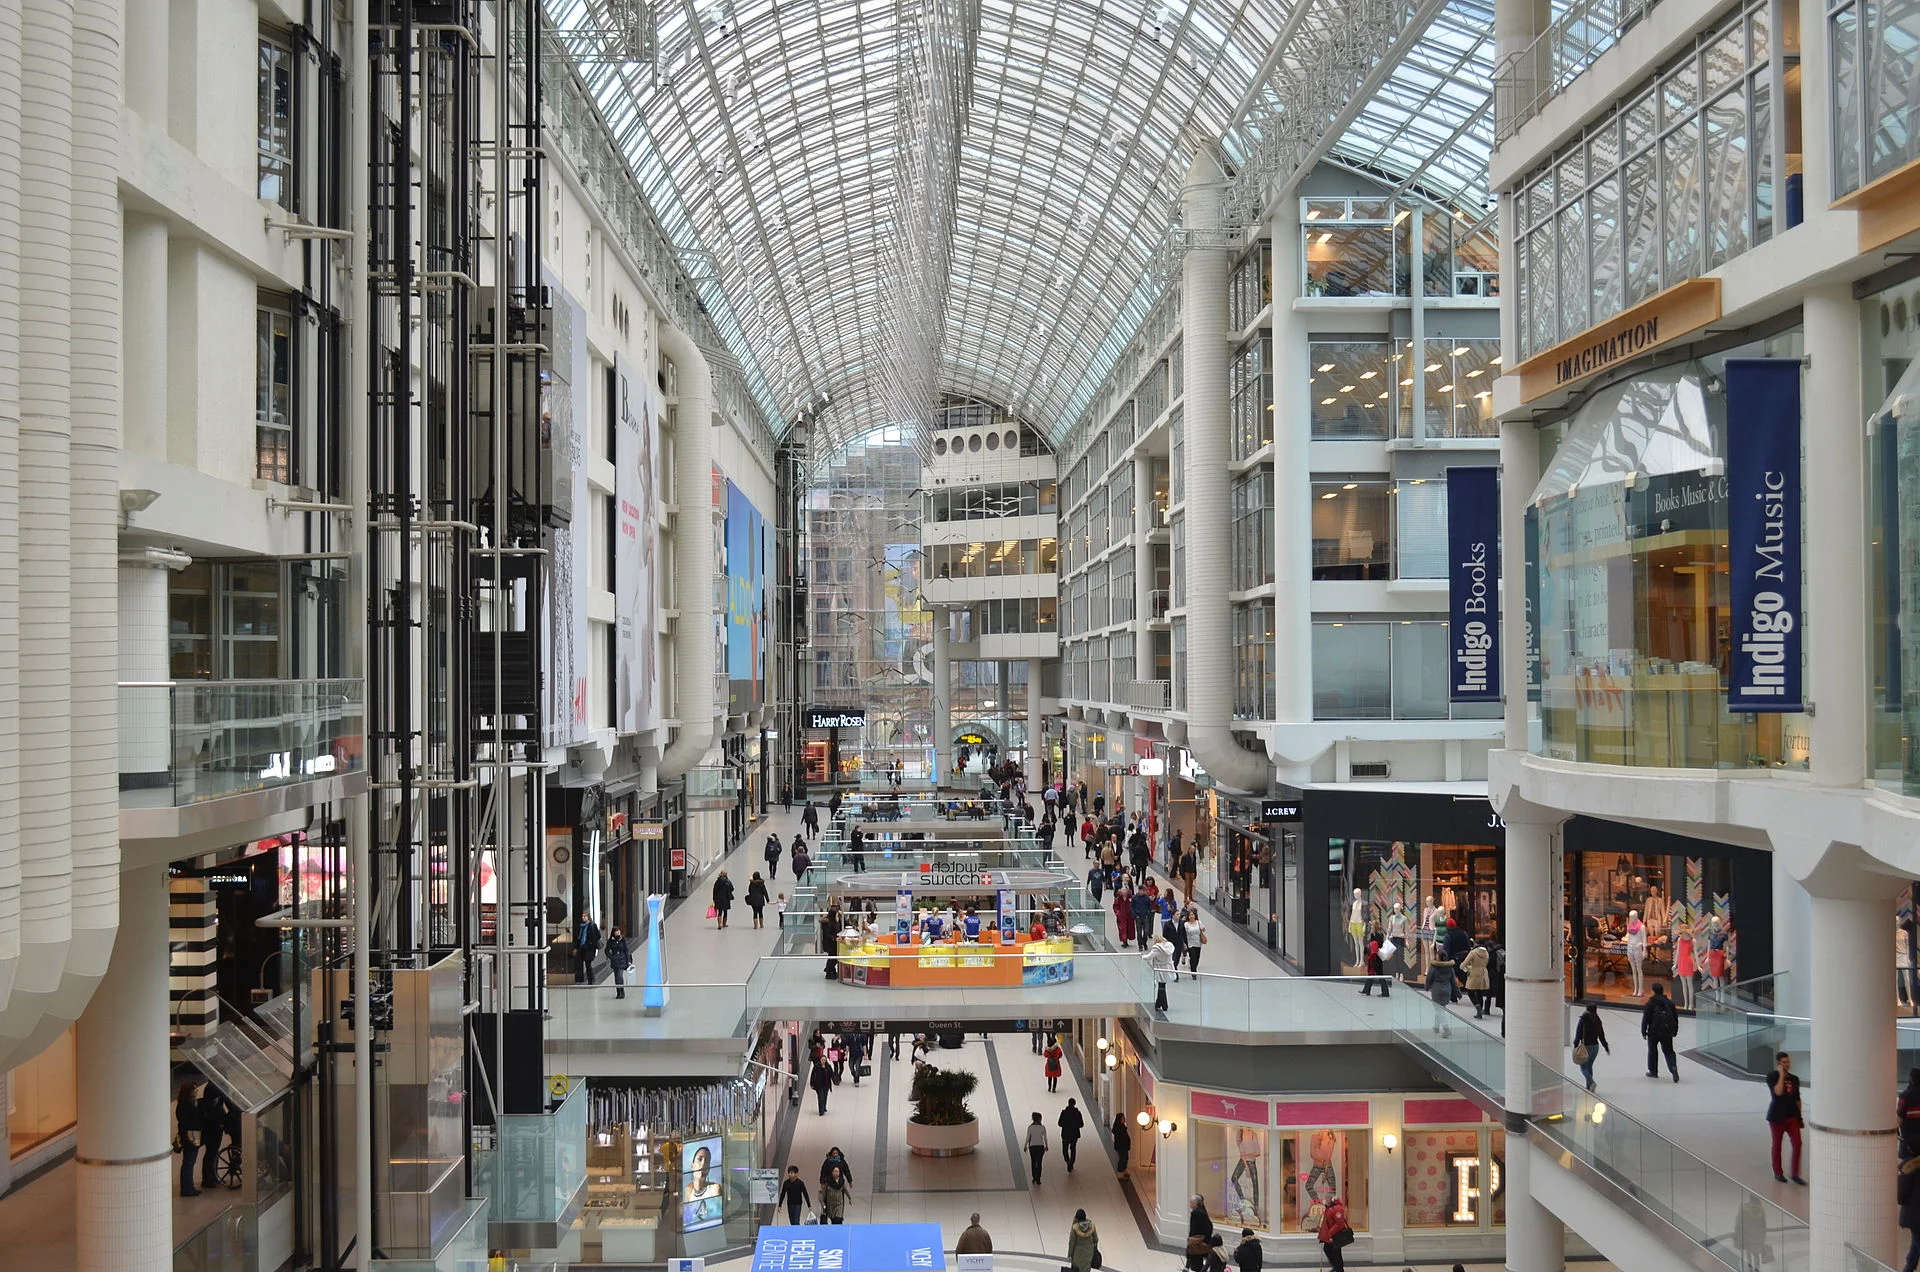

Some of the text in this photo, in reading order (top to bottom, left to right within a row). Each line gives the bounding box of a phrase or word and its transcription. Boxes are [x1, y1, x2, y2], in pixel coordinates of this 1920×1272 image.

[1557, 316, 1658, 384] IMAGINATION
[1655, 488, 1680, 513] Books
[1681, 483, 1707, 507] Music
[1708, 481, 1714, 501] &
[1740, 471, 1793, 695] Indigo Music
[1457, 542, 1492, 691] Indigo Books
[812, 714, 867, 728] HARRY ROSEN
[1265, 808, 1297, 816] J.CREW
[920, 872, 980, 886] swatch
[928, 1021, 953, 1029] Queen
[758, 1238, 788, 1271] CENTRE
[787, 1239, 816, 1271] HEALTH
[818, 1248, 844, 1269] SKIN
[911, 1247, 933, 1267] VICHY
